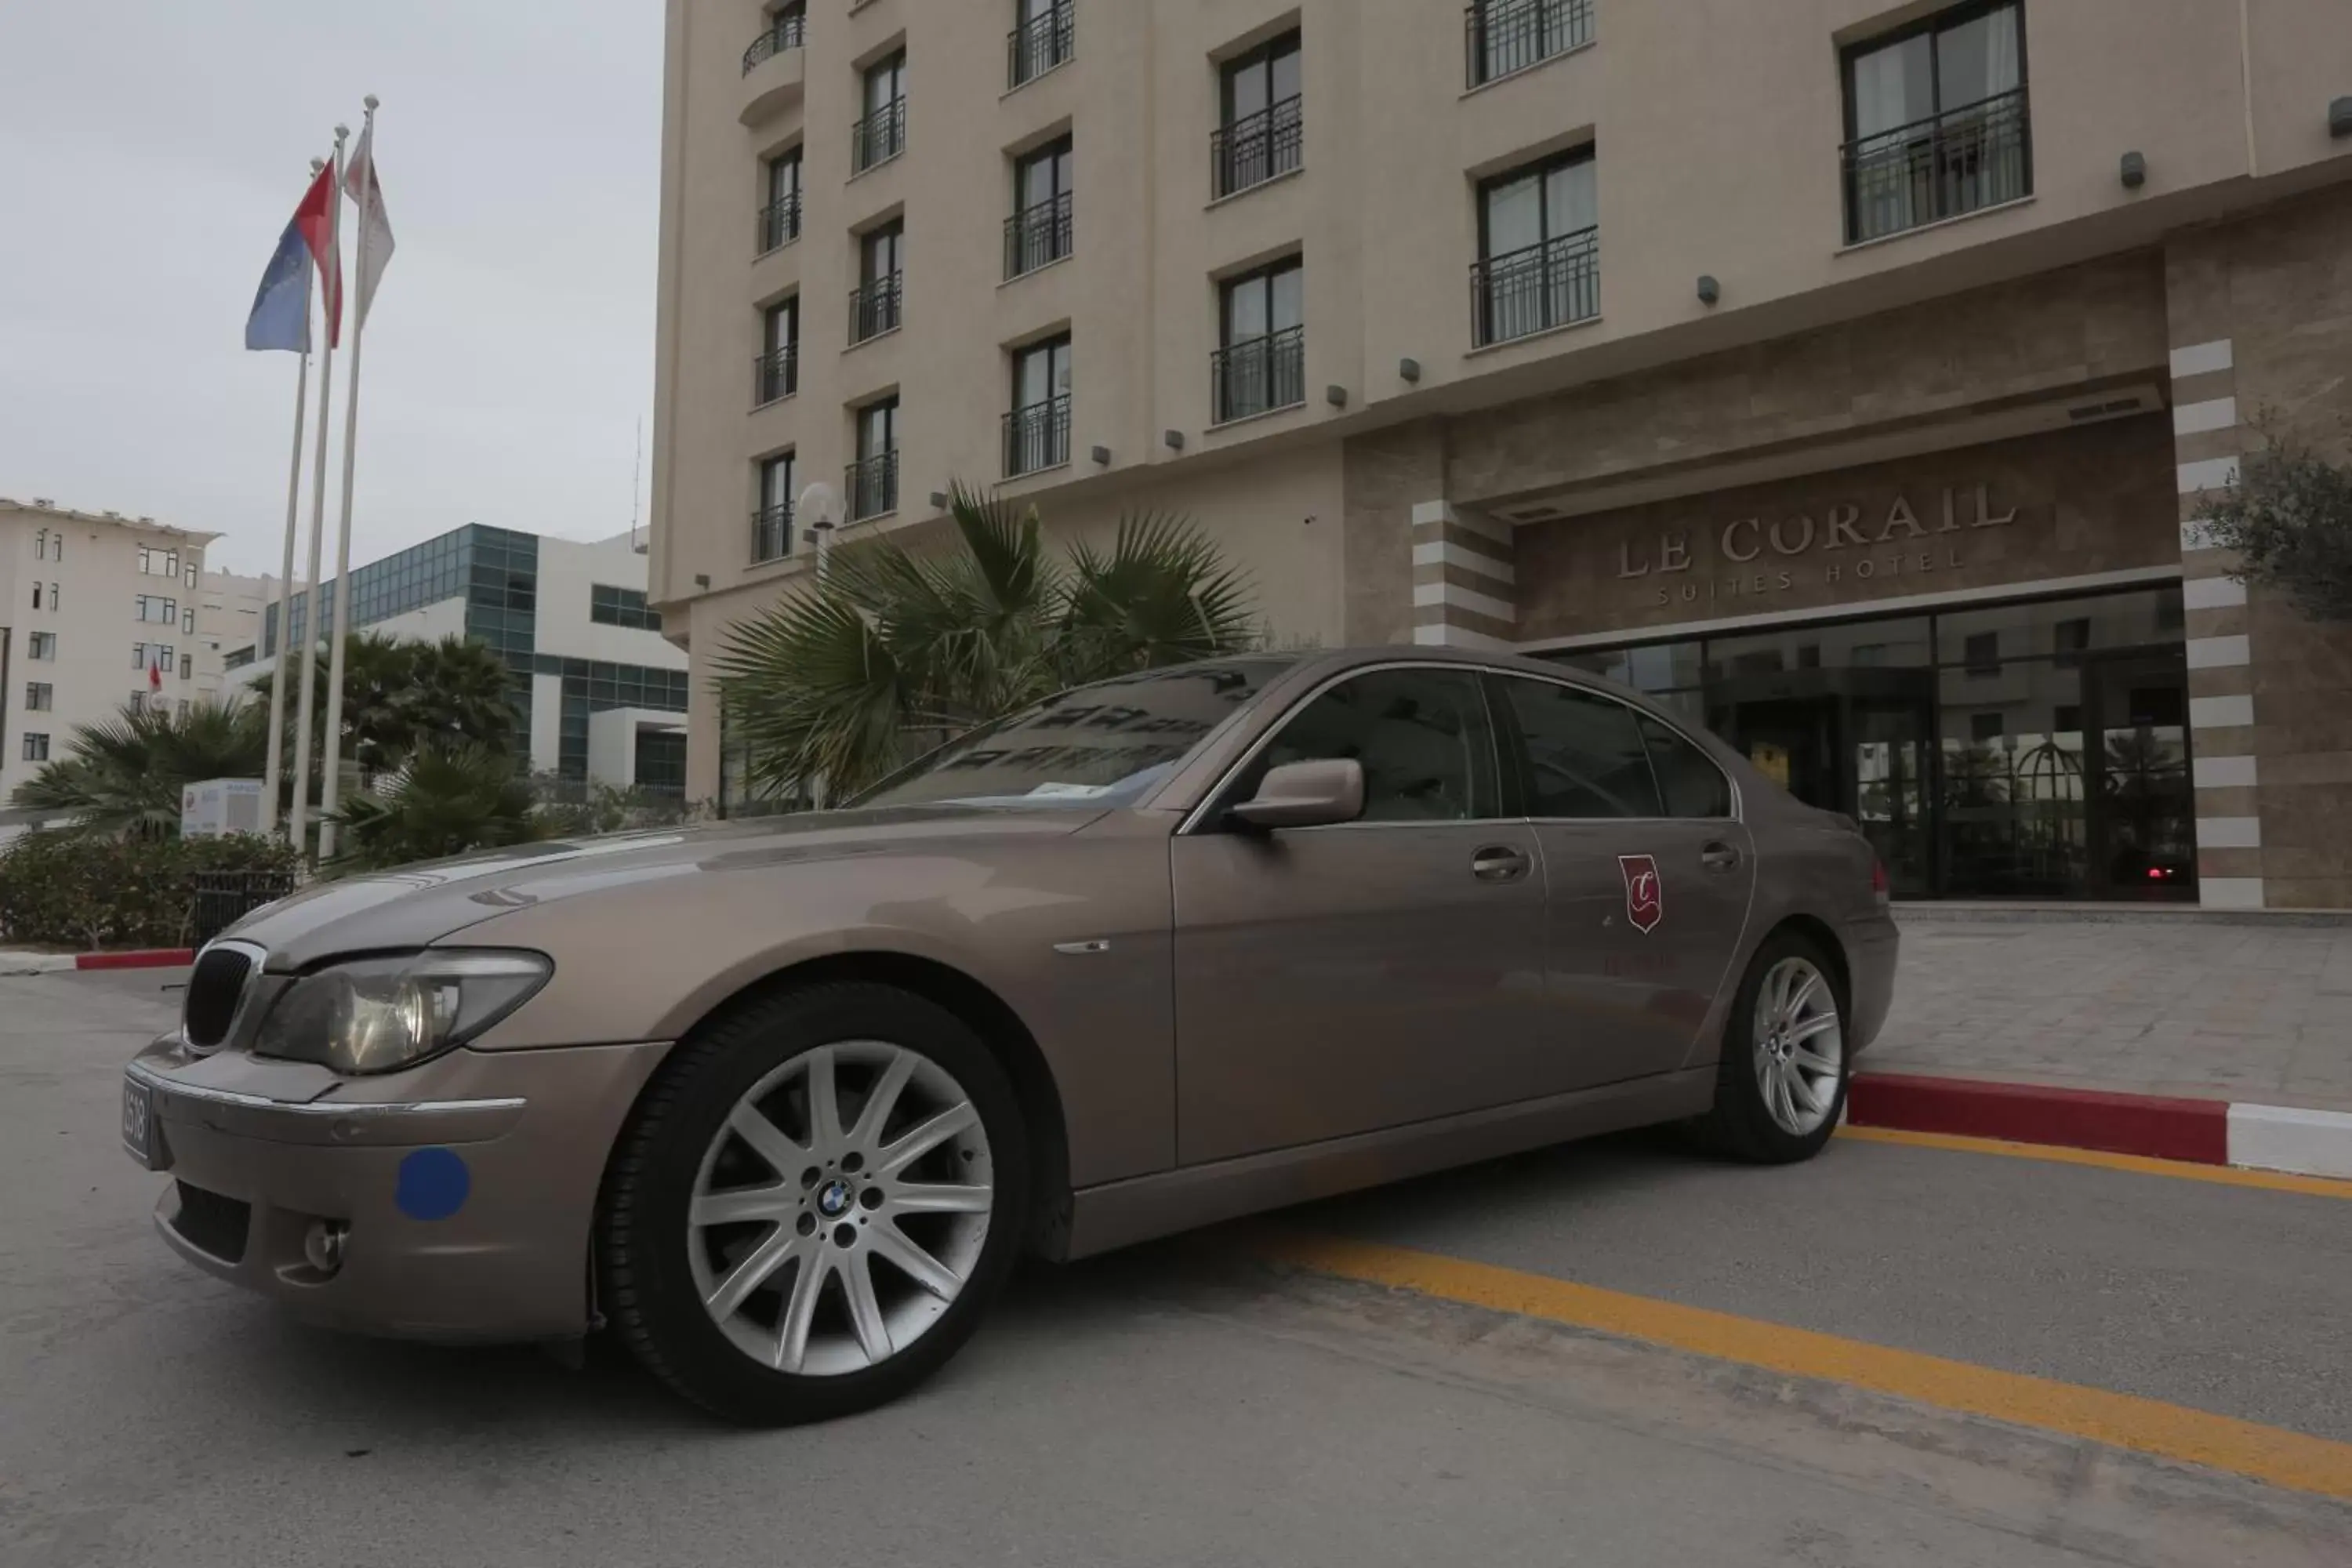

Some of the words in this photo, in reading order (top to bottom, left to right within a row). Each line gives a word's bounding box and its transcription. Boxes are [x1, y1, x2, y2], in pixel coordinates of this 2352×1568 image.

[1616, 532, 1693, 579] LE
[1721, 481, 2018, 562] CORAIL
[1657, 571, 1792, 605] SUITES
[1825, 549, 1965, 584] HOTEL
